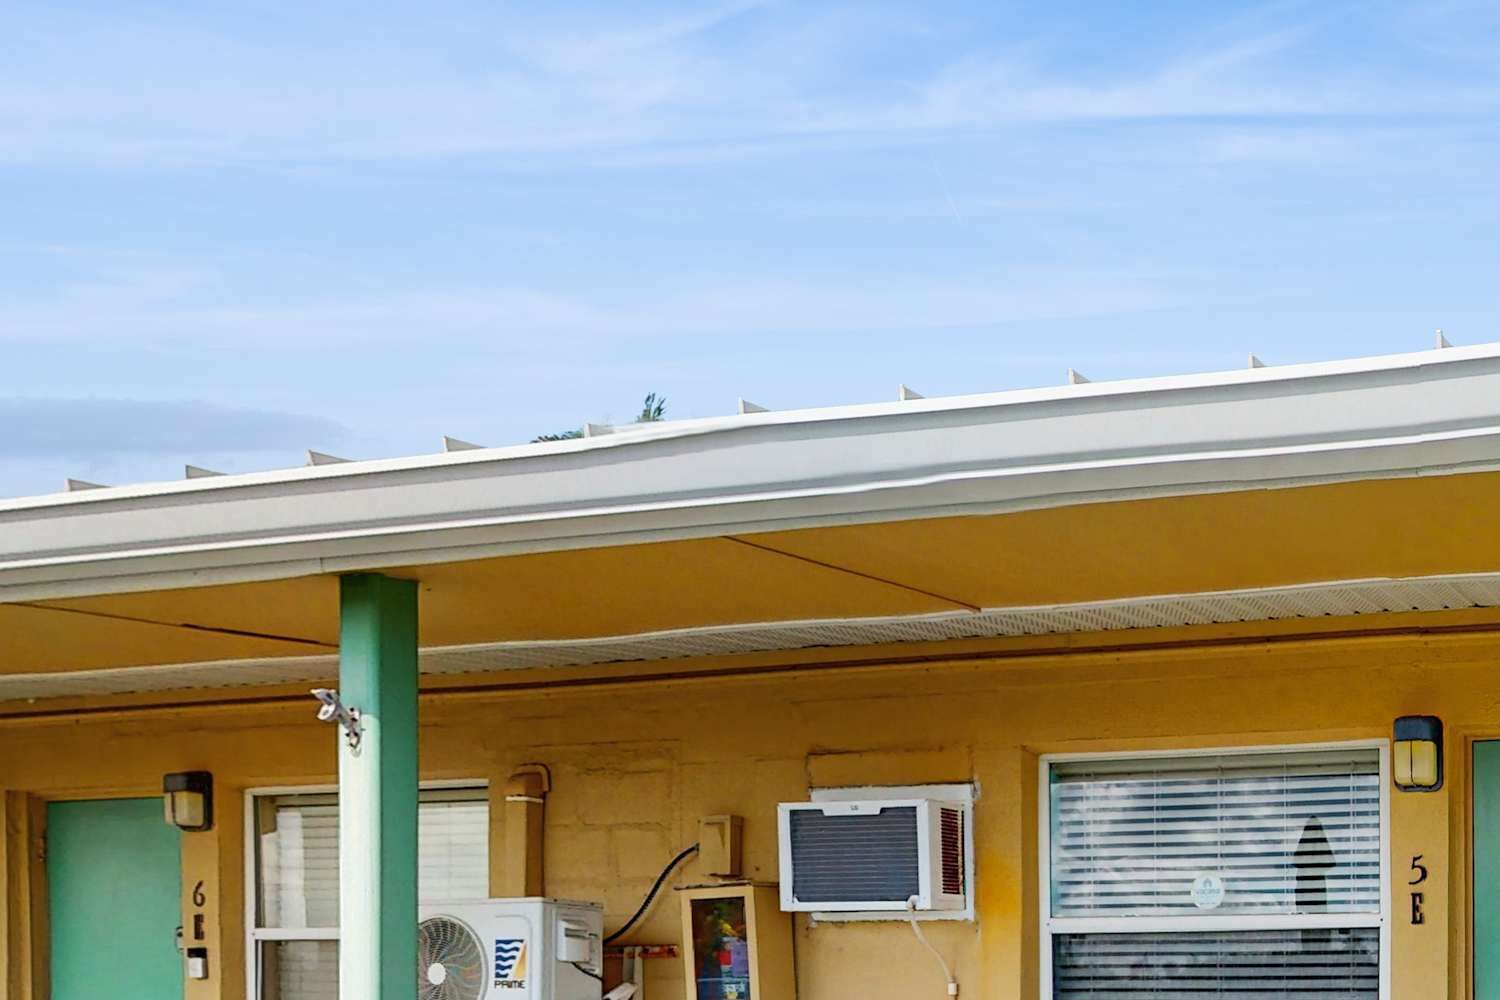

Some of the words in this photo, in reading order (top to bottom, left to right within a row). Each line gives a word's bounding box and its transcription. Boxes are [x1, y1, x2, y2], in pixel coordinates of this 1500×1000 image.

[1408, 854, 1427, 885] 5
[193, 880, 206, 907] 6
[1411, 893, 1424, 925] E
[494, 980, 526, 989] PRIME
